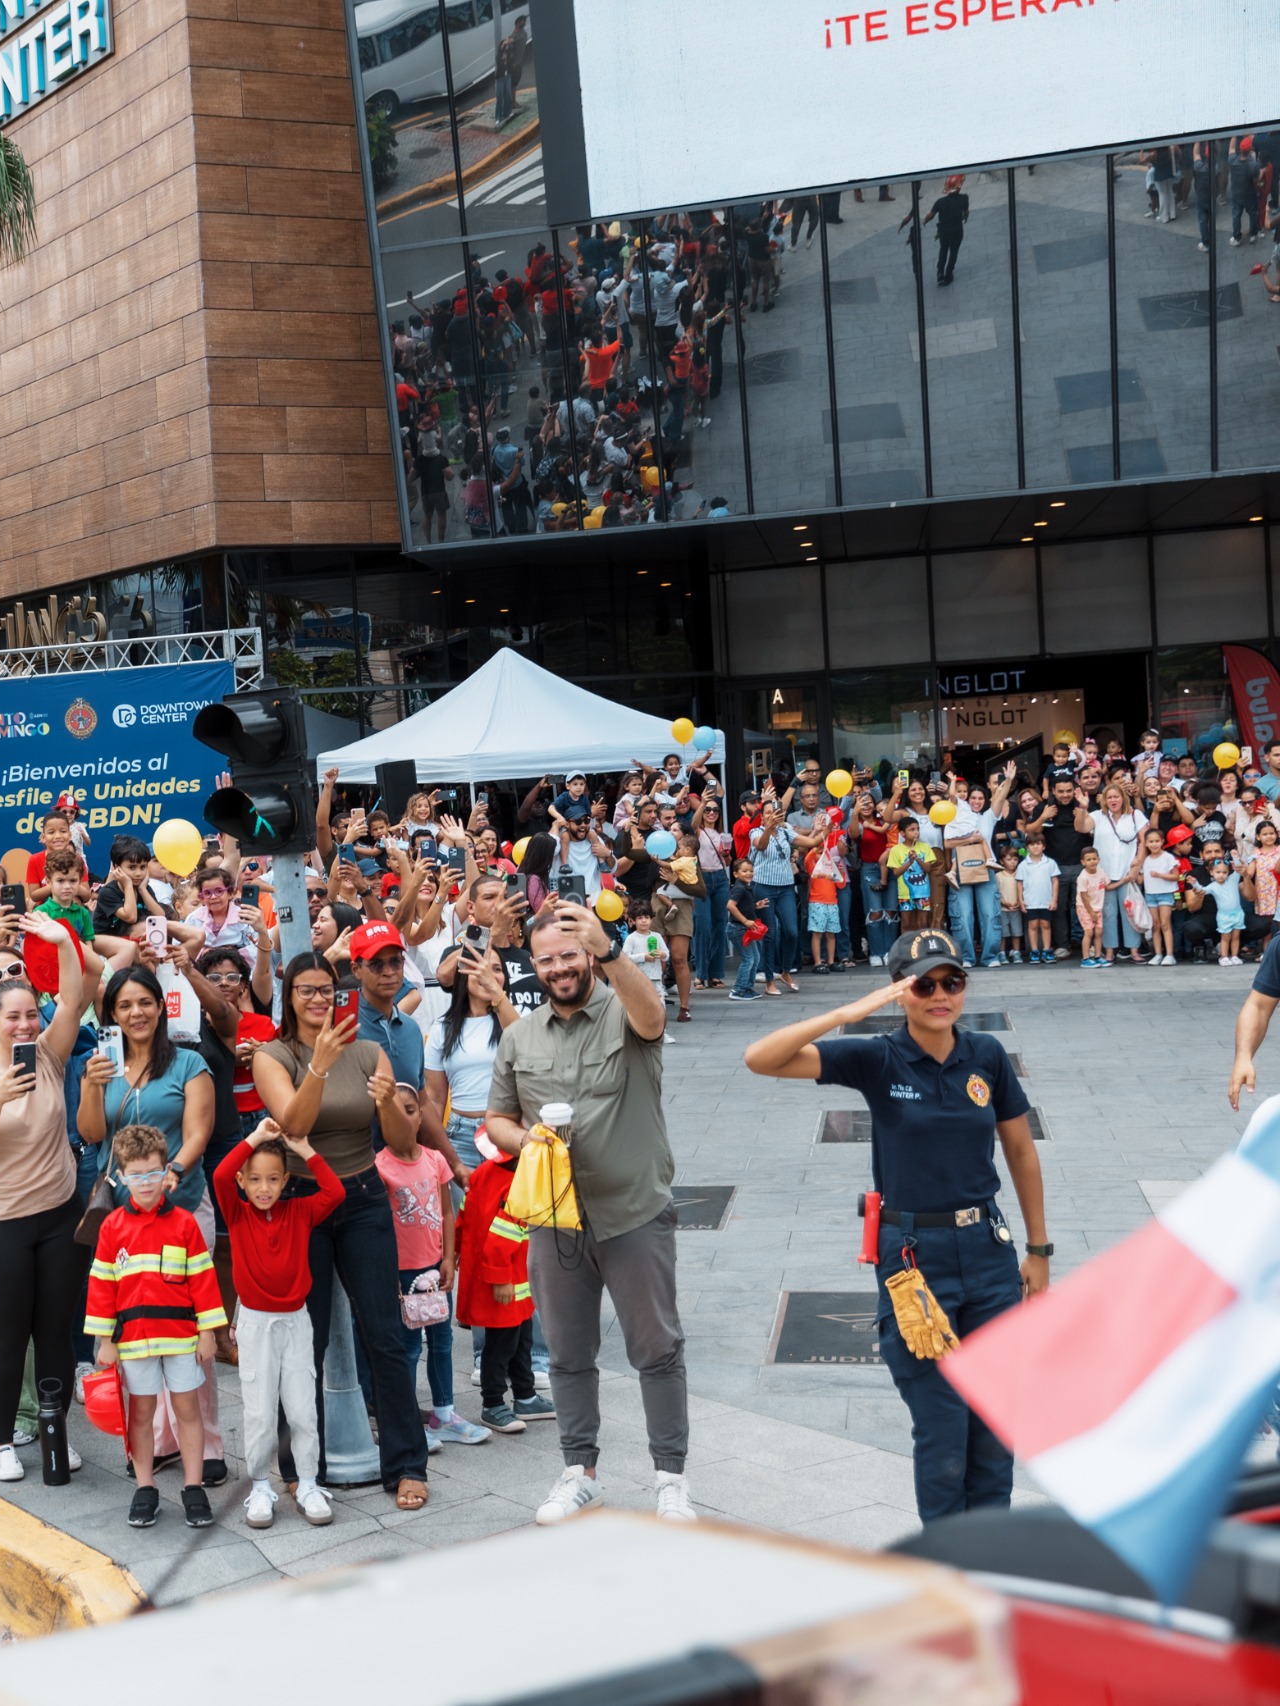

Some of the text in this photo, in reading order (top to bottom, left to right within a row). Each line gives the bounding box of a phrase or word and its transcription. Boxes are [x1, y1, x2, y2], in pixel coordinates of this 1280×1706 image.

[824, 0, 1120, 48] ¡TE ESPER
[924, 670, 1026, 697] INGLOT
[772, 688, 784, 704] A
[140, 700, 213, 715] DOWNTOWN
[141, 712, 187, 725] CENTER
[1, 753, 169, 786] ¡Bienvenidos al
[93, 777, 201, 801] Unidades
[515, 991, 532, 1005] DO
[890, 1090, 914, 1099] WINTER
